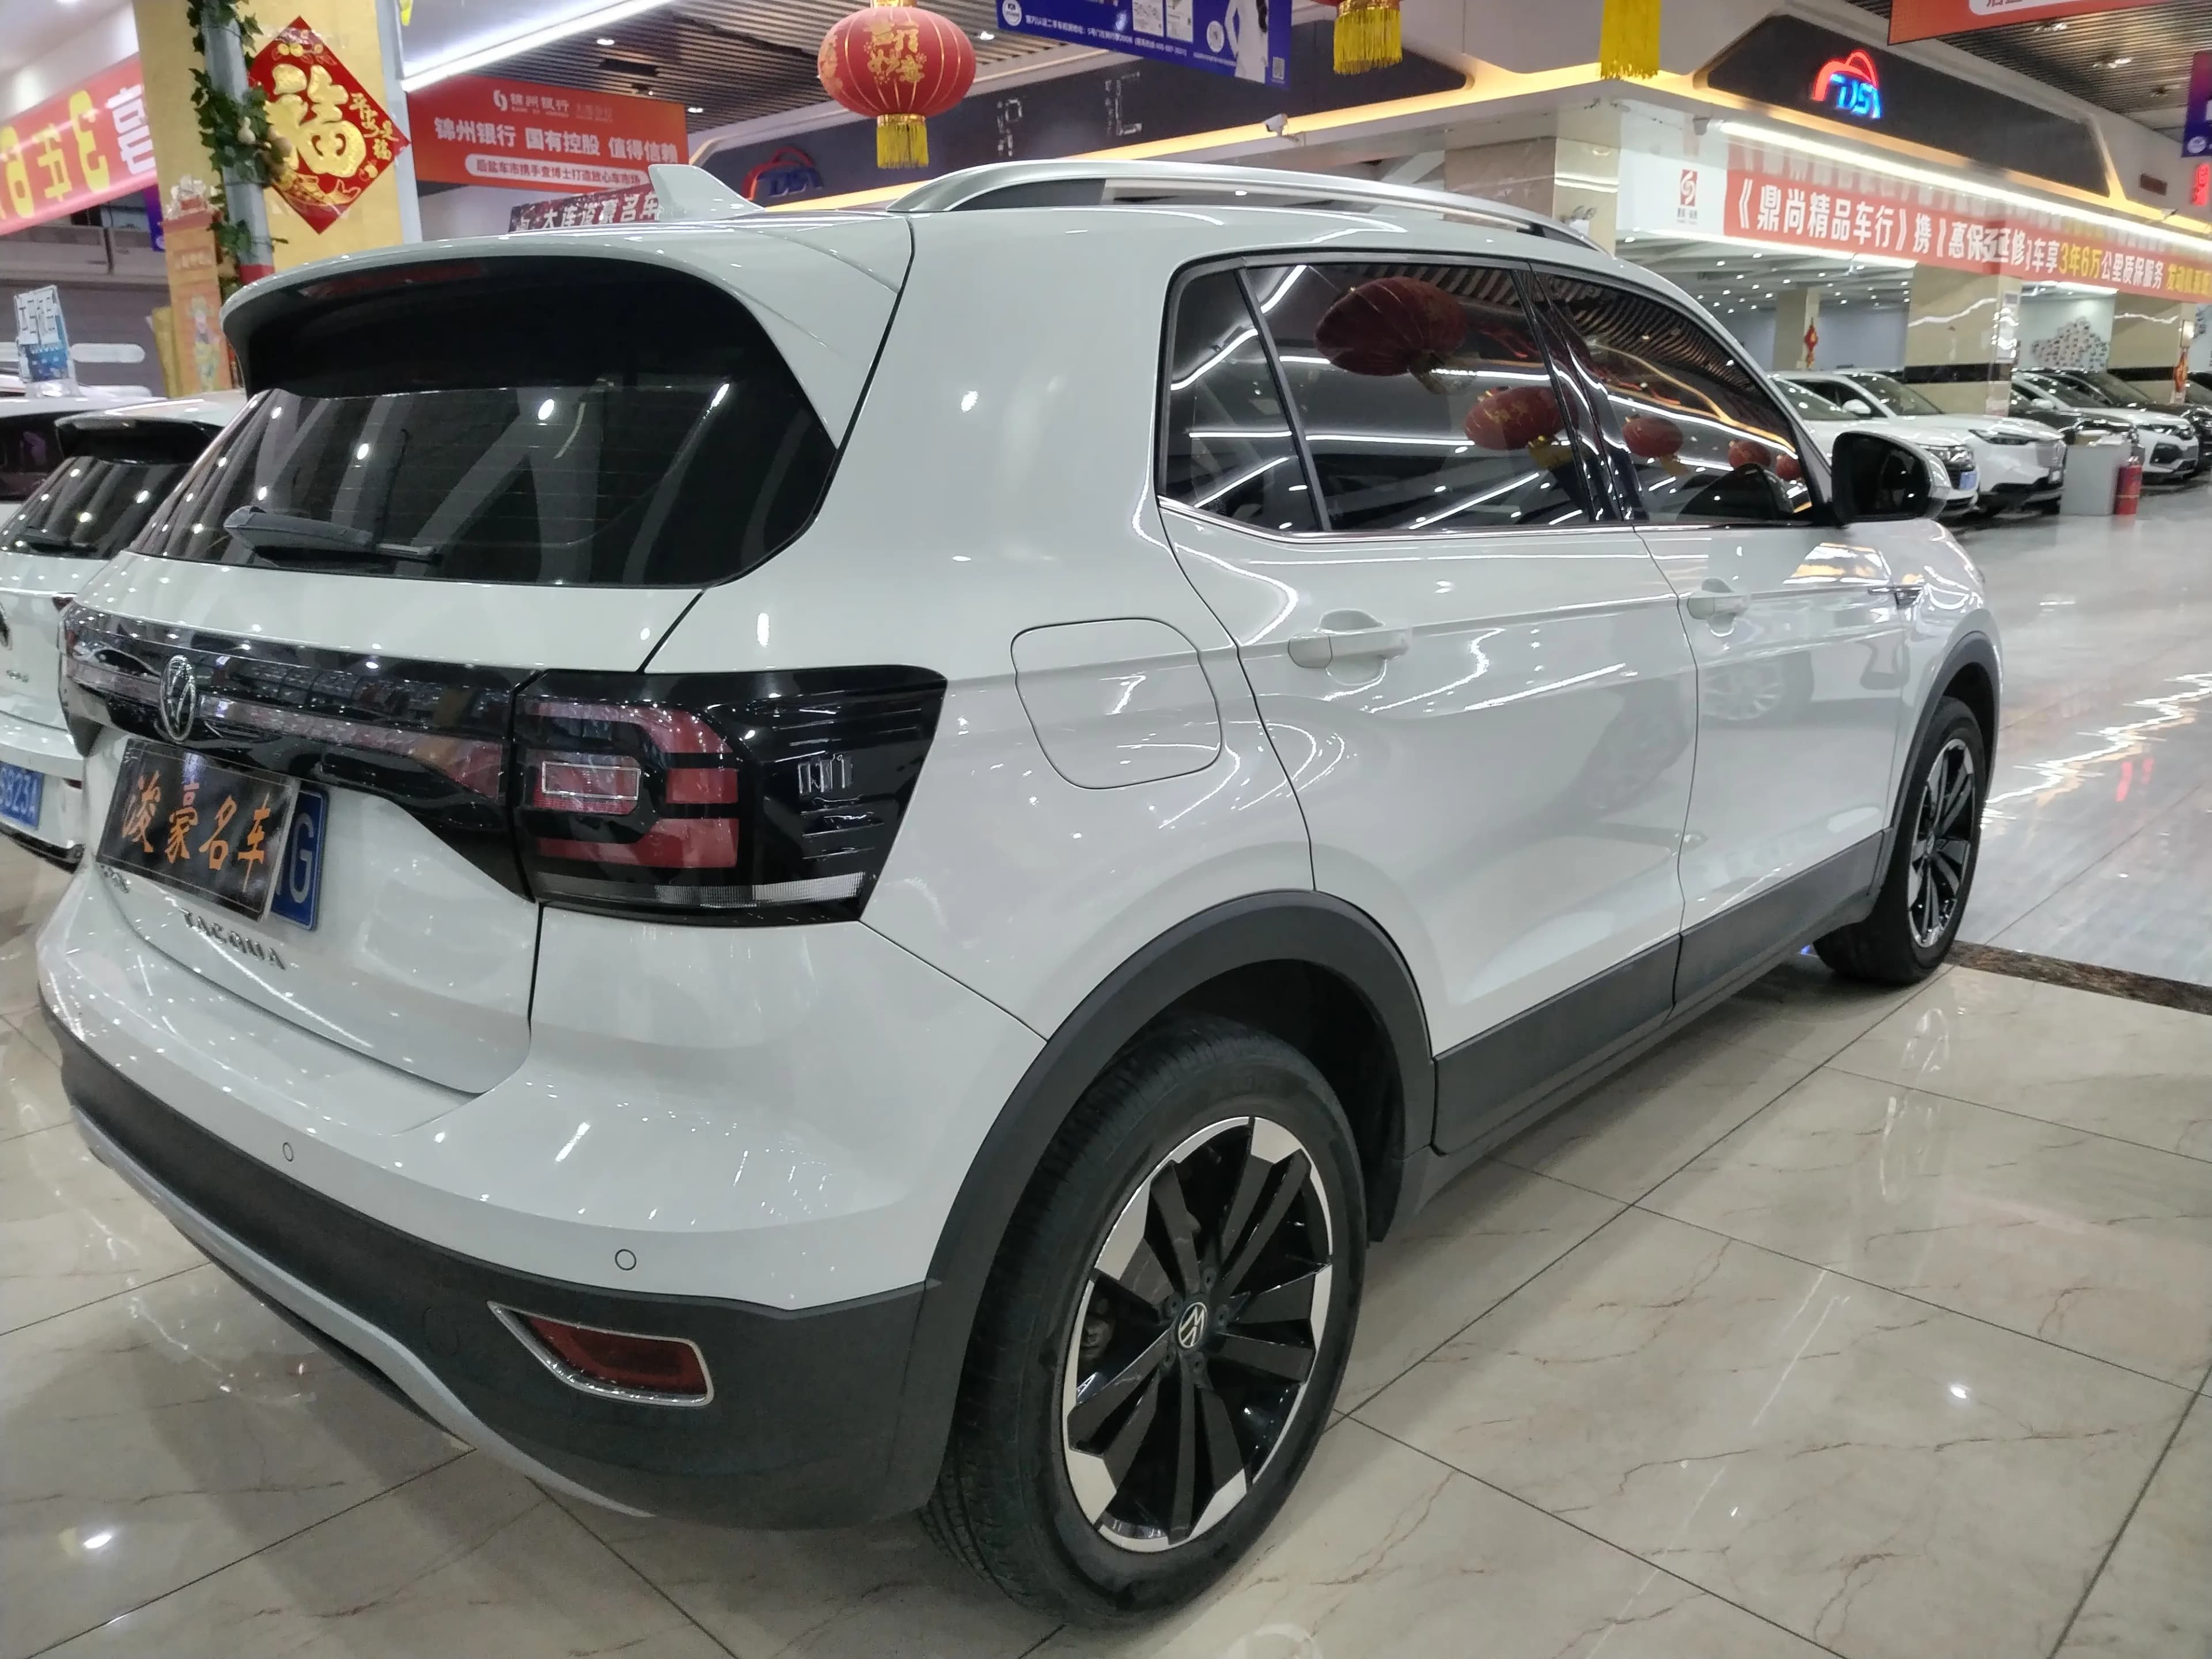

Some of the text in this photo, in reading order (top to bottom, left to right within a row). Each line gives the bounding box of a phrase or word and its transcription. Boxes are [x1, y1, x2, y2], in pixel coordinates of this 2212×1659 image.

[263, 63, 366, 177] 福
[434, 118, 679, 164] 锦州银行 国有控股 值得信赖
